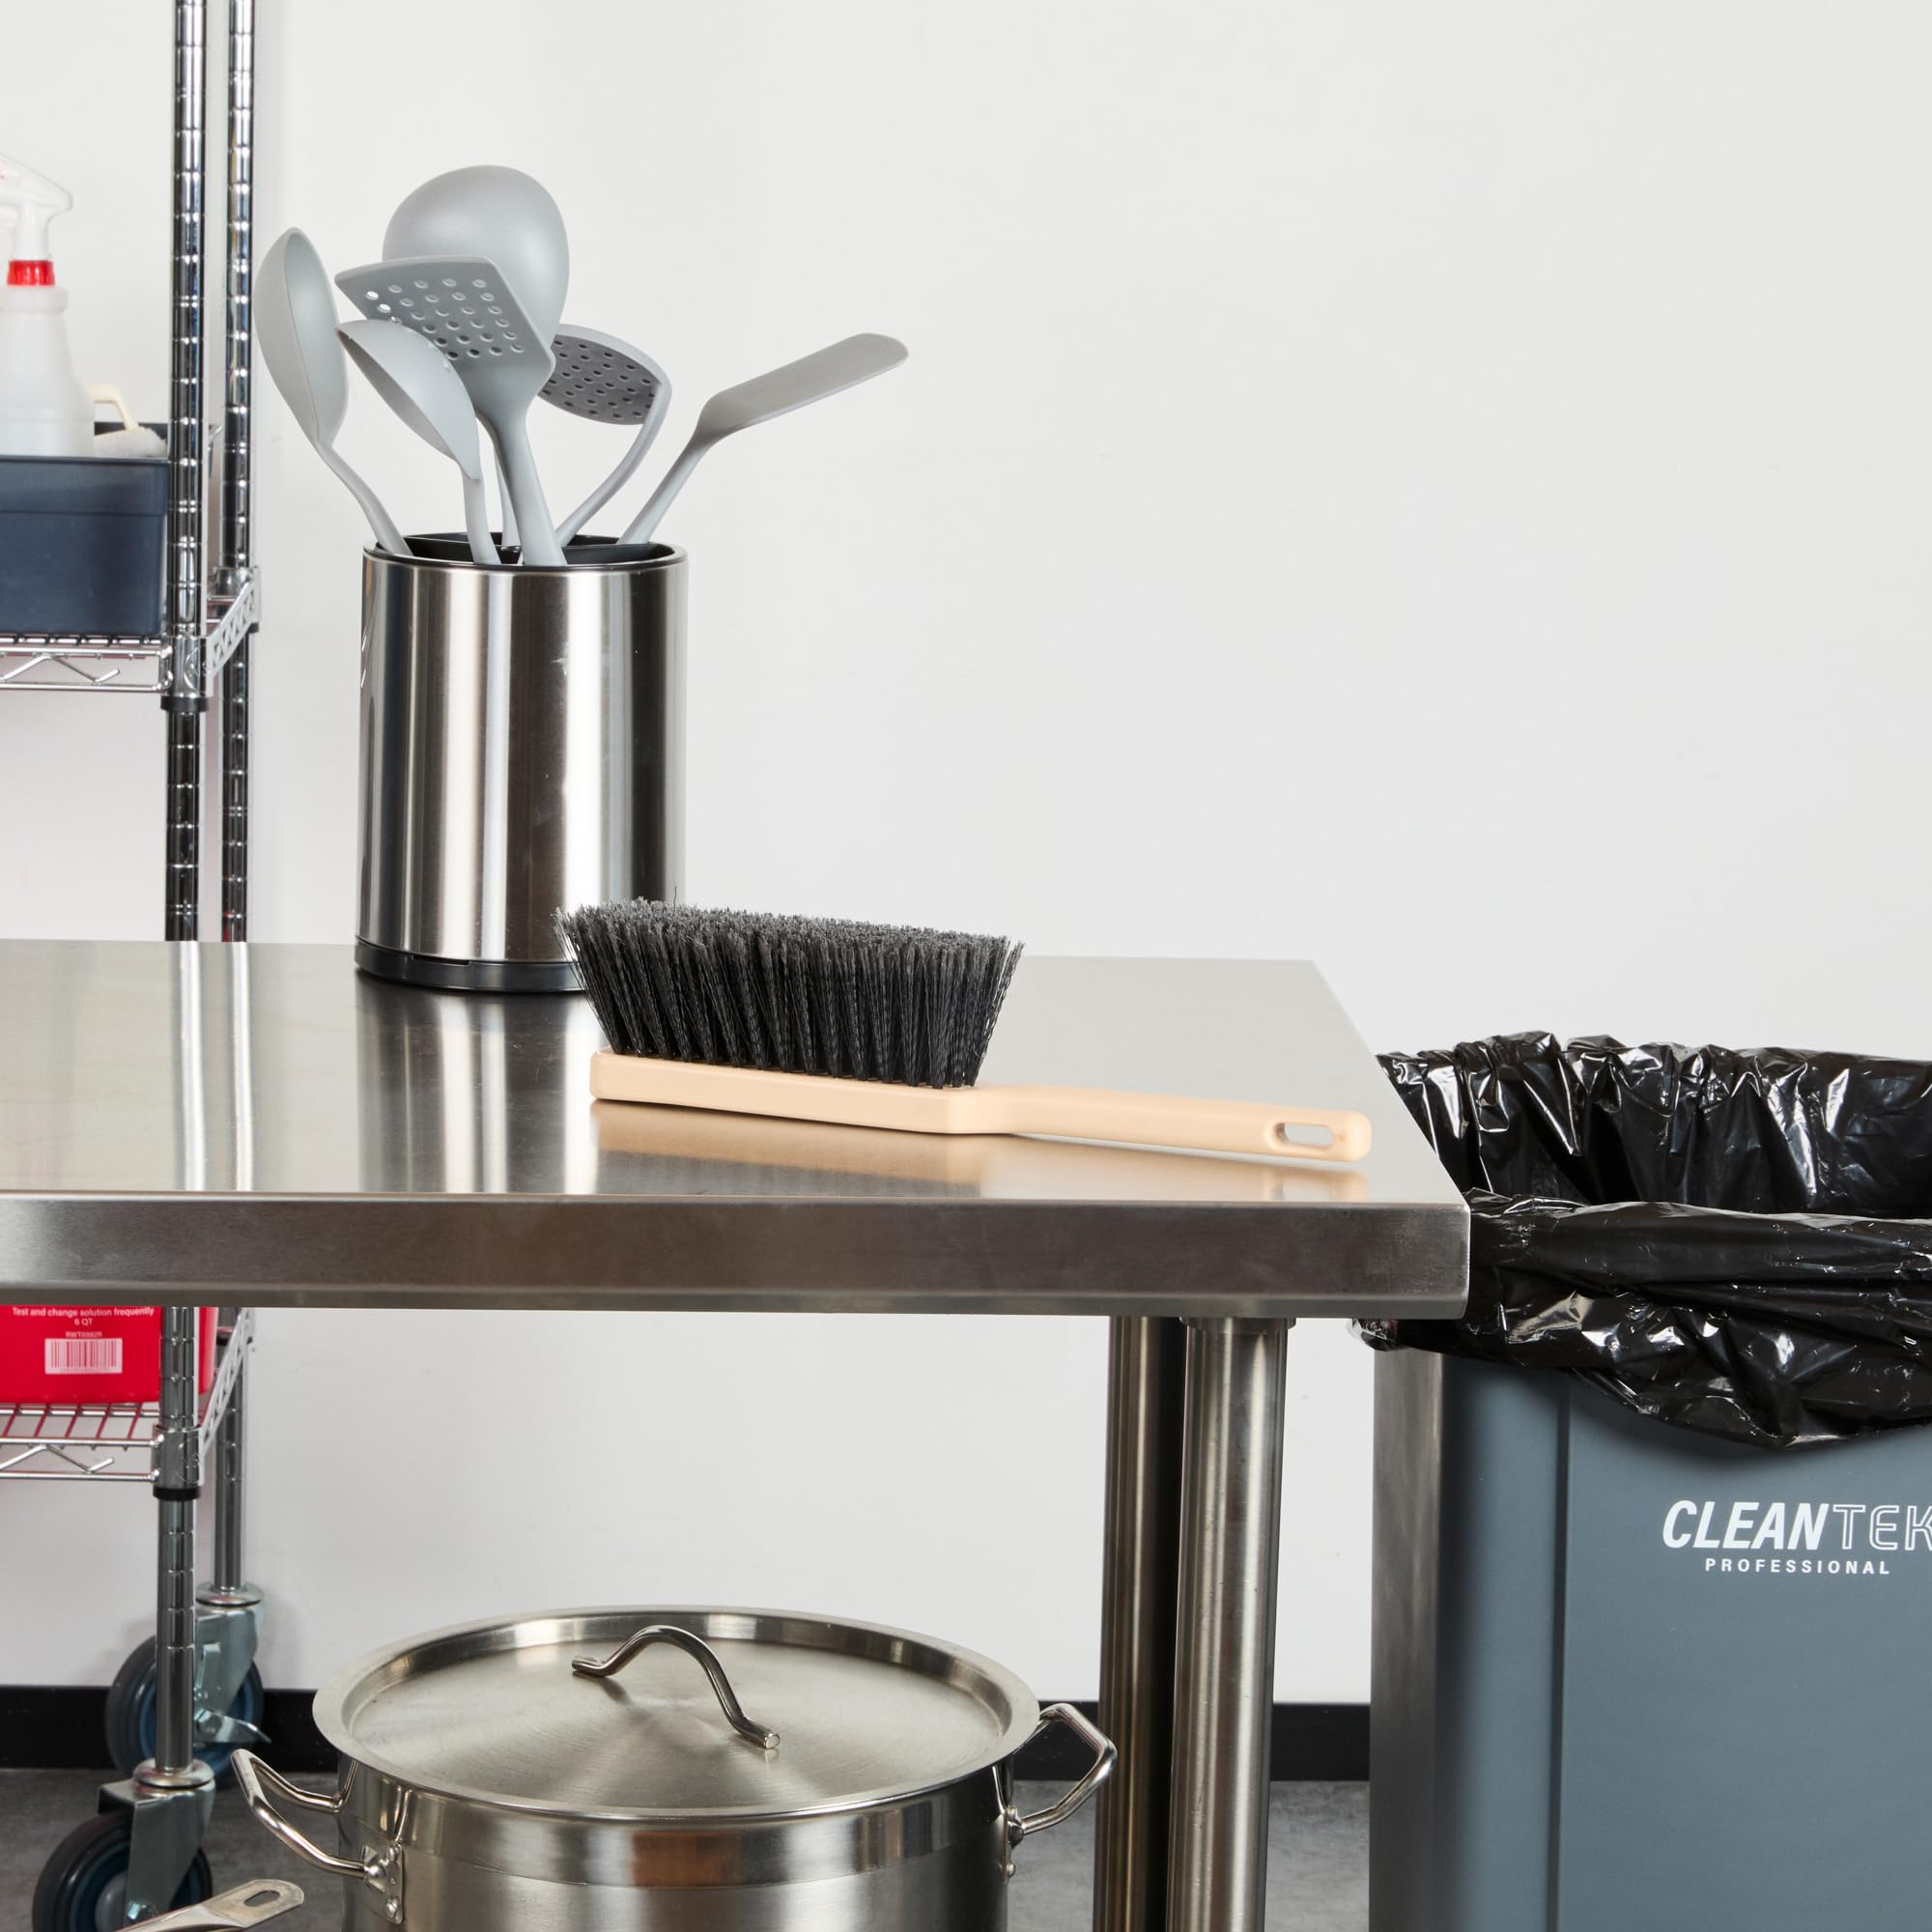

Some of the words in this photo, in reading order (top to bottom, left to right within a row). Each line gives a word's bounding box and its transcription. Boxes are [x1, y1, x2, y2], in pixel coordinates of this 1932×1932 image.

[13, 1307, 29, 1317] Test
[30, 1308, 46, 1317] and
[47, 1308, 78, 1319] change
[80, 1308, 112, 1317] solution
[114, 1306, 155, 1317] frequently
[73, 1318, 80, 1326] 6
[81, 1318, 93, 1326] QT
[1662, 1499, 1932, 1551] CLEANTEK
[1705, 1557, 1890, 1575] PROFESSIONAL
